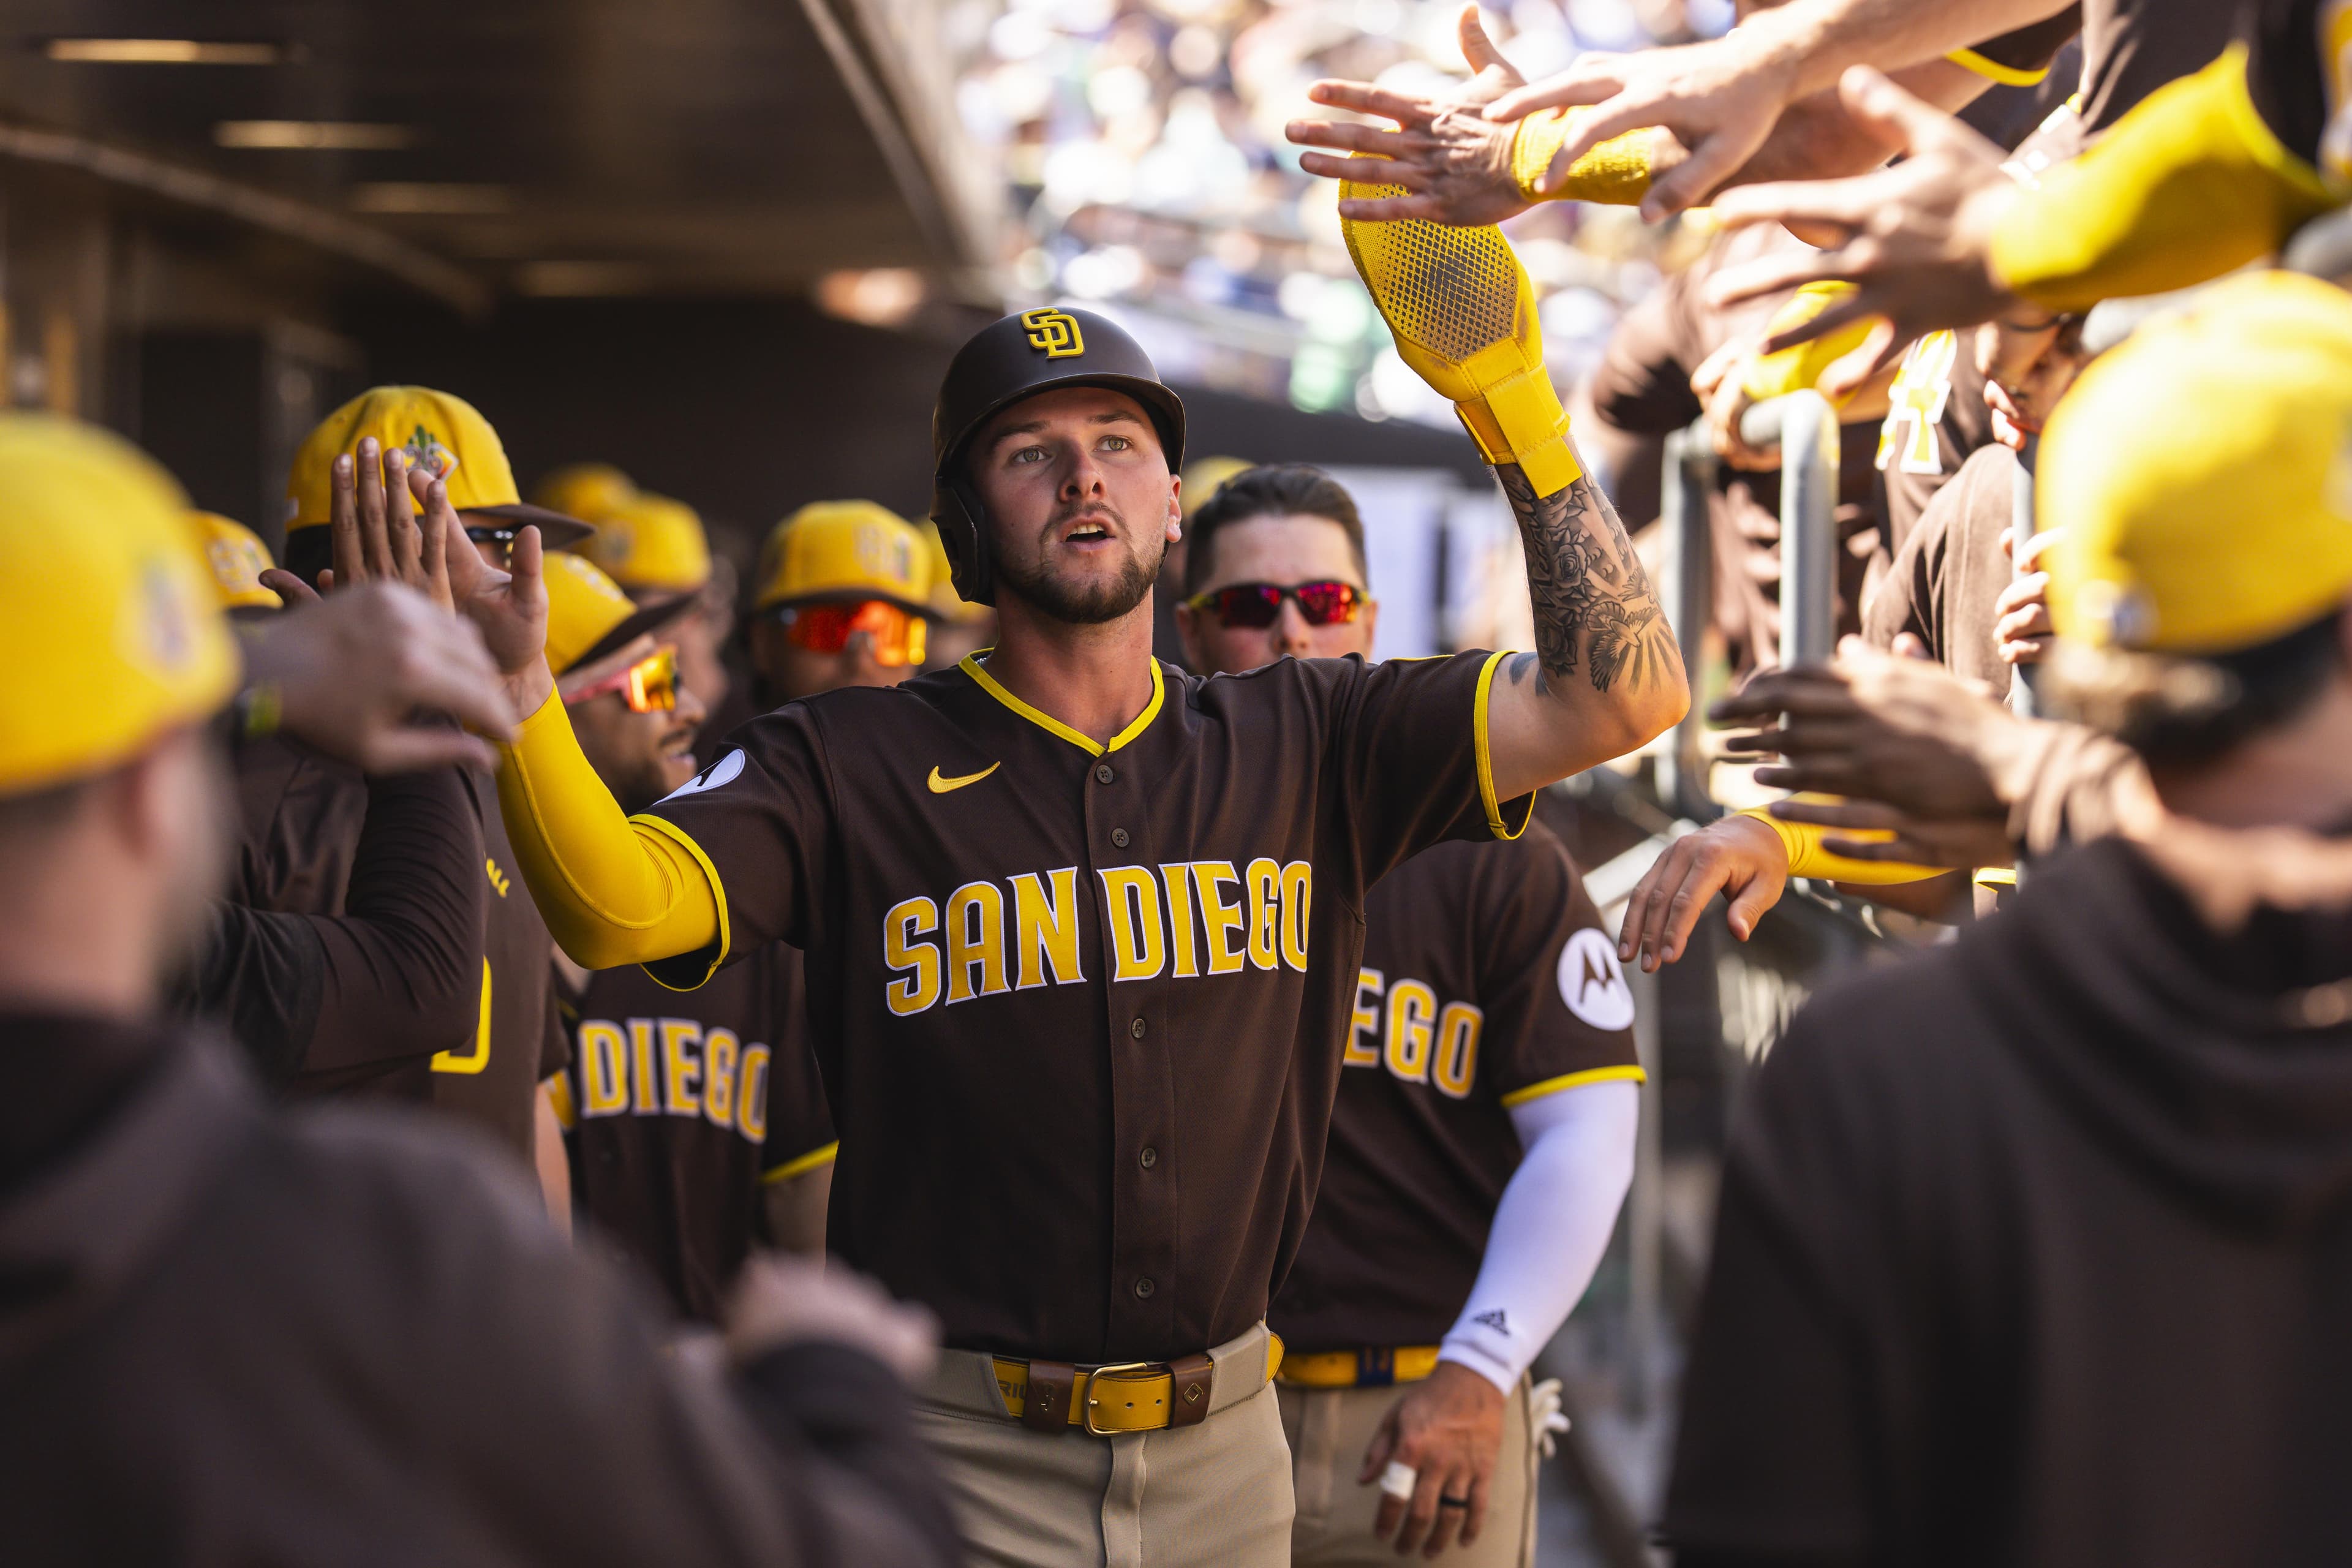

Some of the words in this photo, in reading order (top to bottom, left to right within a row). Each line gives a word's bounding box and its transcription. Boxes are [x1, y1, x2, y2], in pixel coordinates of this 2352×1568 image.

[1020, 307, 1085, 358] SD
[884, 866, 1087, 1016] SAN
[1097, 858, 1312, 982] DIEGO
[578, 1017, 771, 1144] DIEGO
